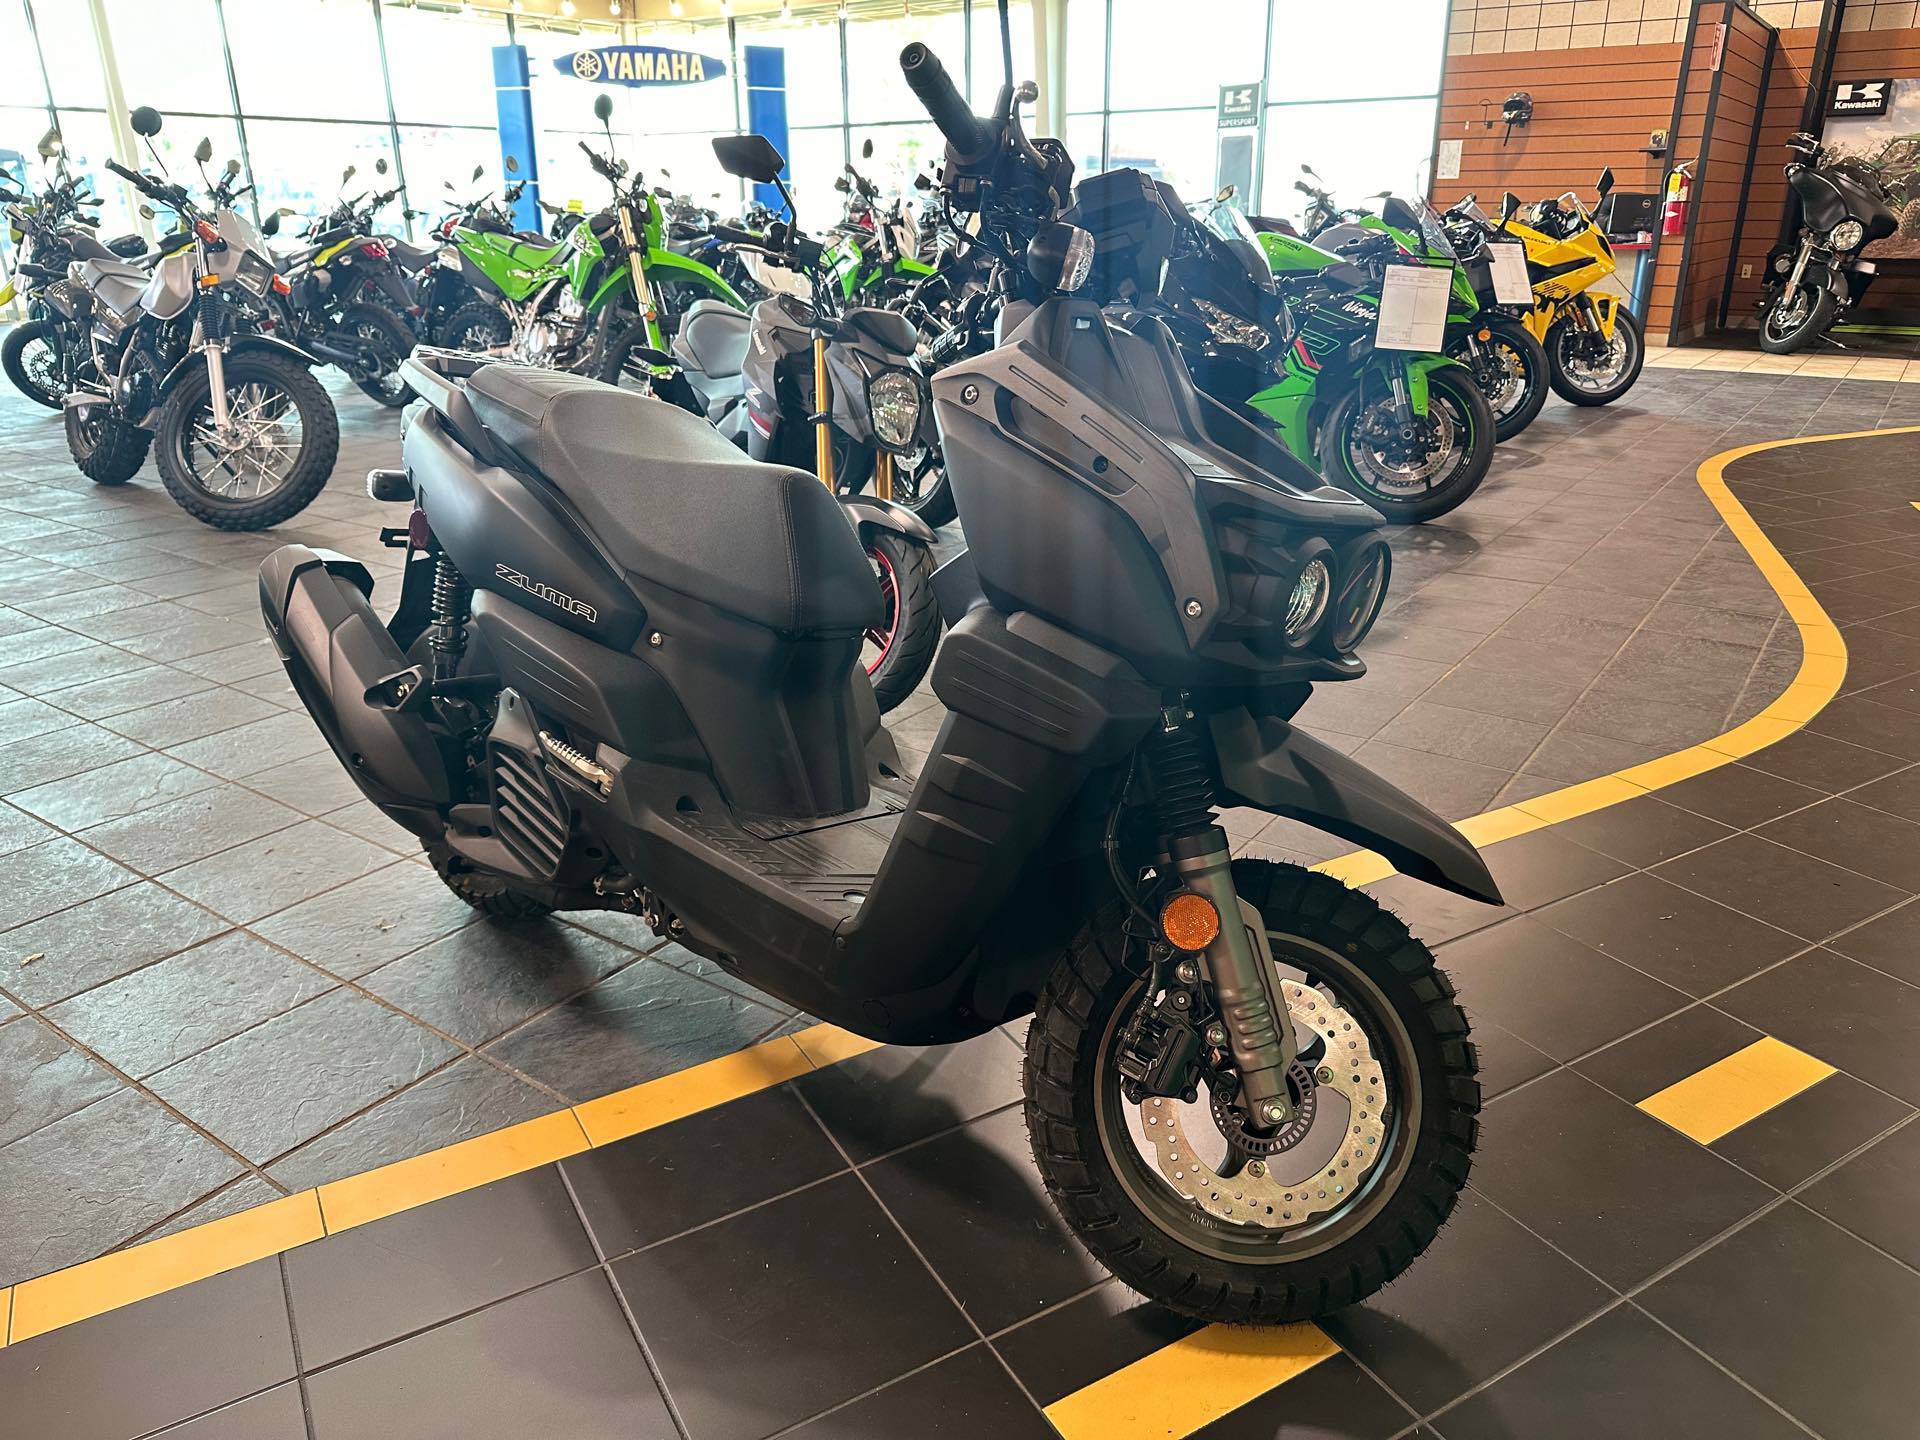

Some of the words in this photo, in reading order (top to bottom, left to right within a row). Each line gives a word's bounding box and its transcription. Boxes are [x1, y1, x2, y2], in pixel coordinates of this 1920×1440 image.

[602, 52, 705, 81] YAMAHA
[1834, 100, 1881, 110] Kawasaki
[1219, 117, 1256, 127] SUPERSPORT
[1342, 300, 1377, 320] Ninja
[496, 563, 598, 624] ZUMA
